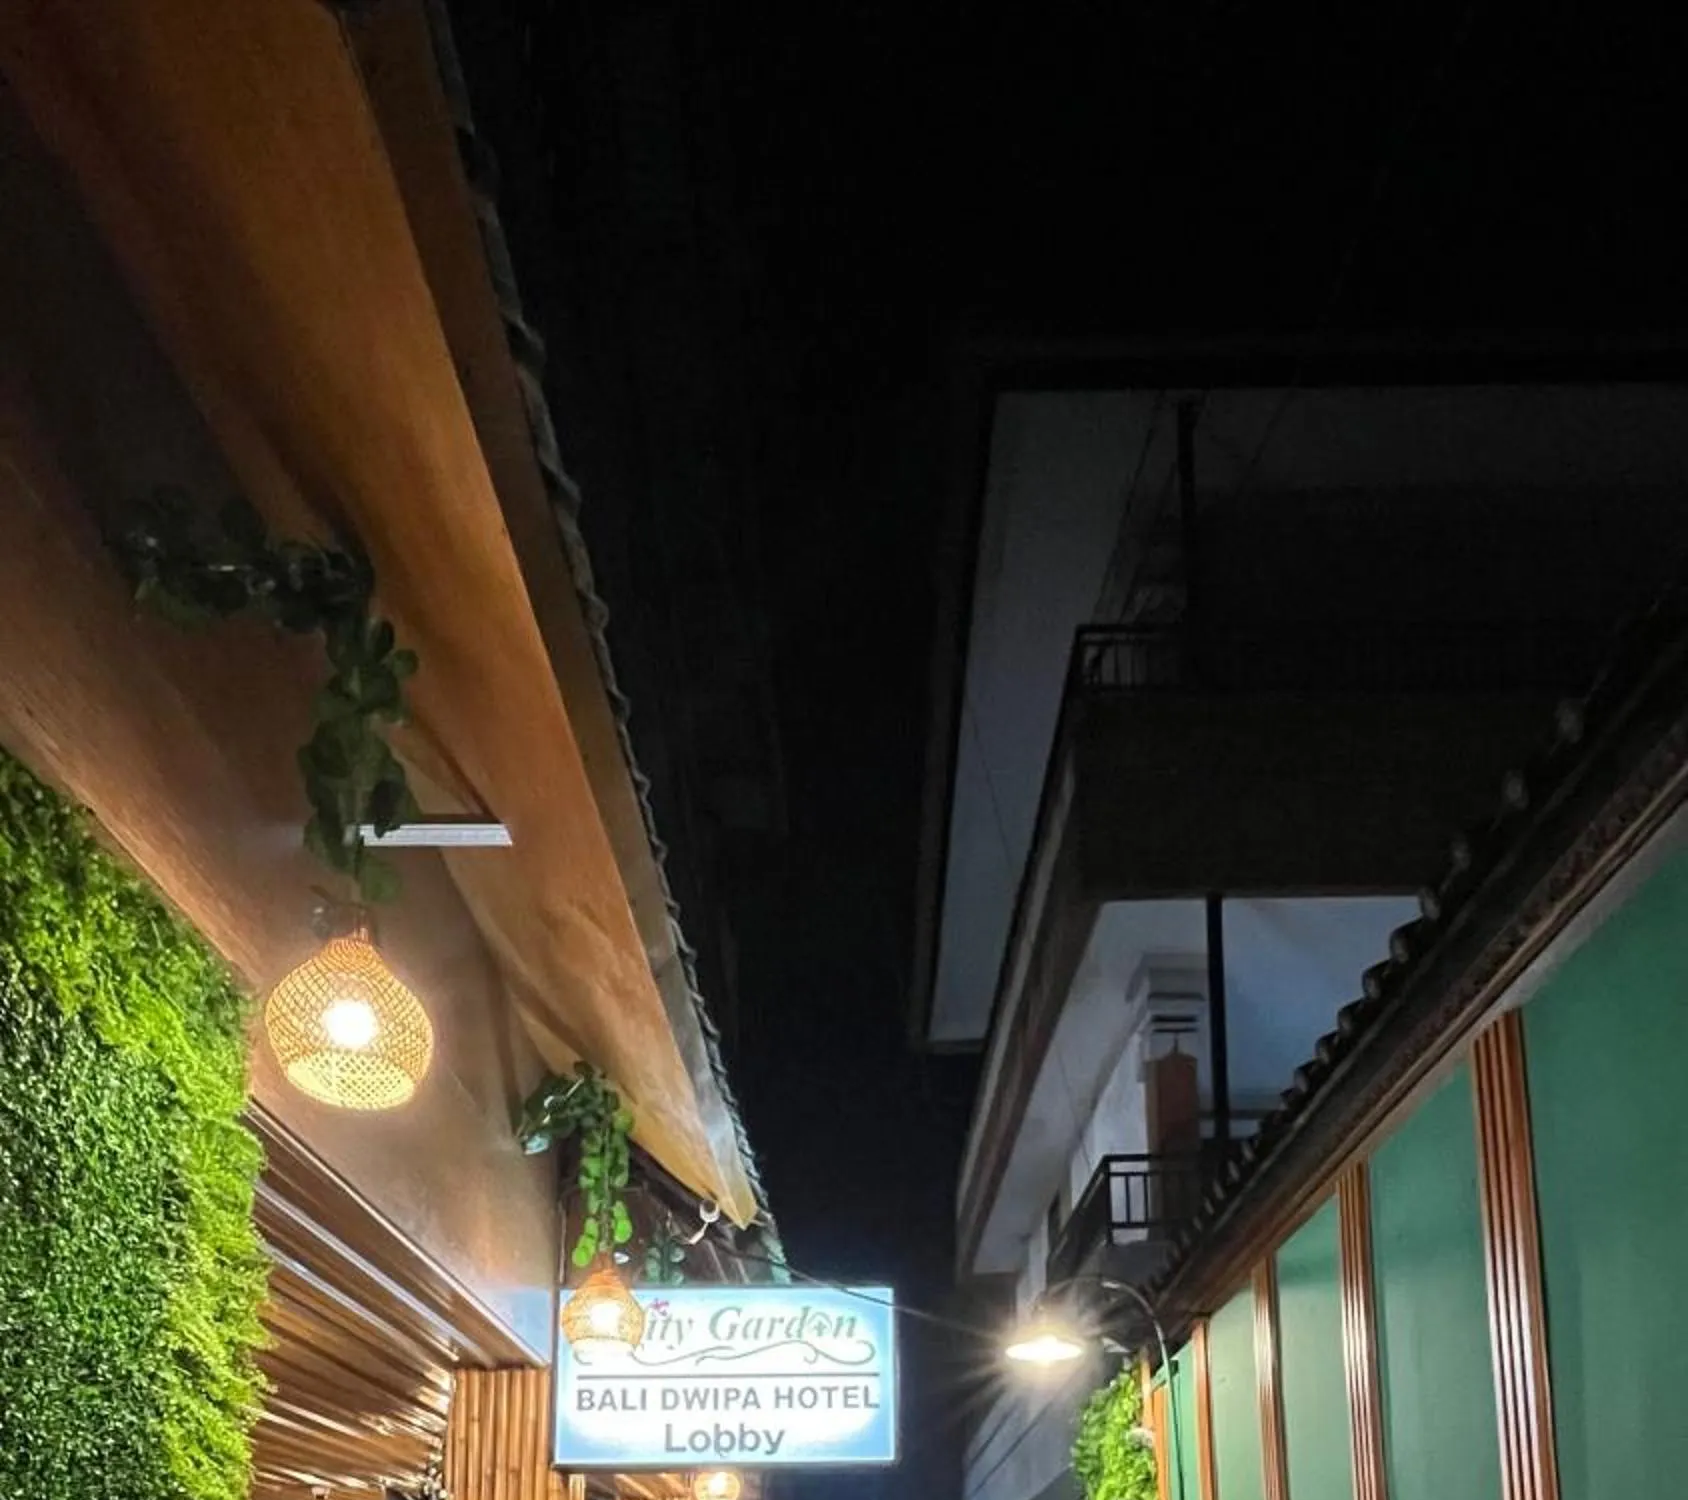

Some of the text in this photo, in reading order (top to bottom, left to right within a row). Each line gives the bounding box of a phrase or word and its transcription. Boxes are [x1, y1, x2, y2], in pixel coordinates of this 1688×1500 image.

[644, 1310, 694, 1351] ity
[576, 1385, 880, 1411] BALI DWIPA HOTEL
[665, 1423, 784, 1455] Lobby
